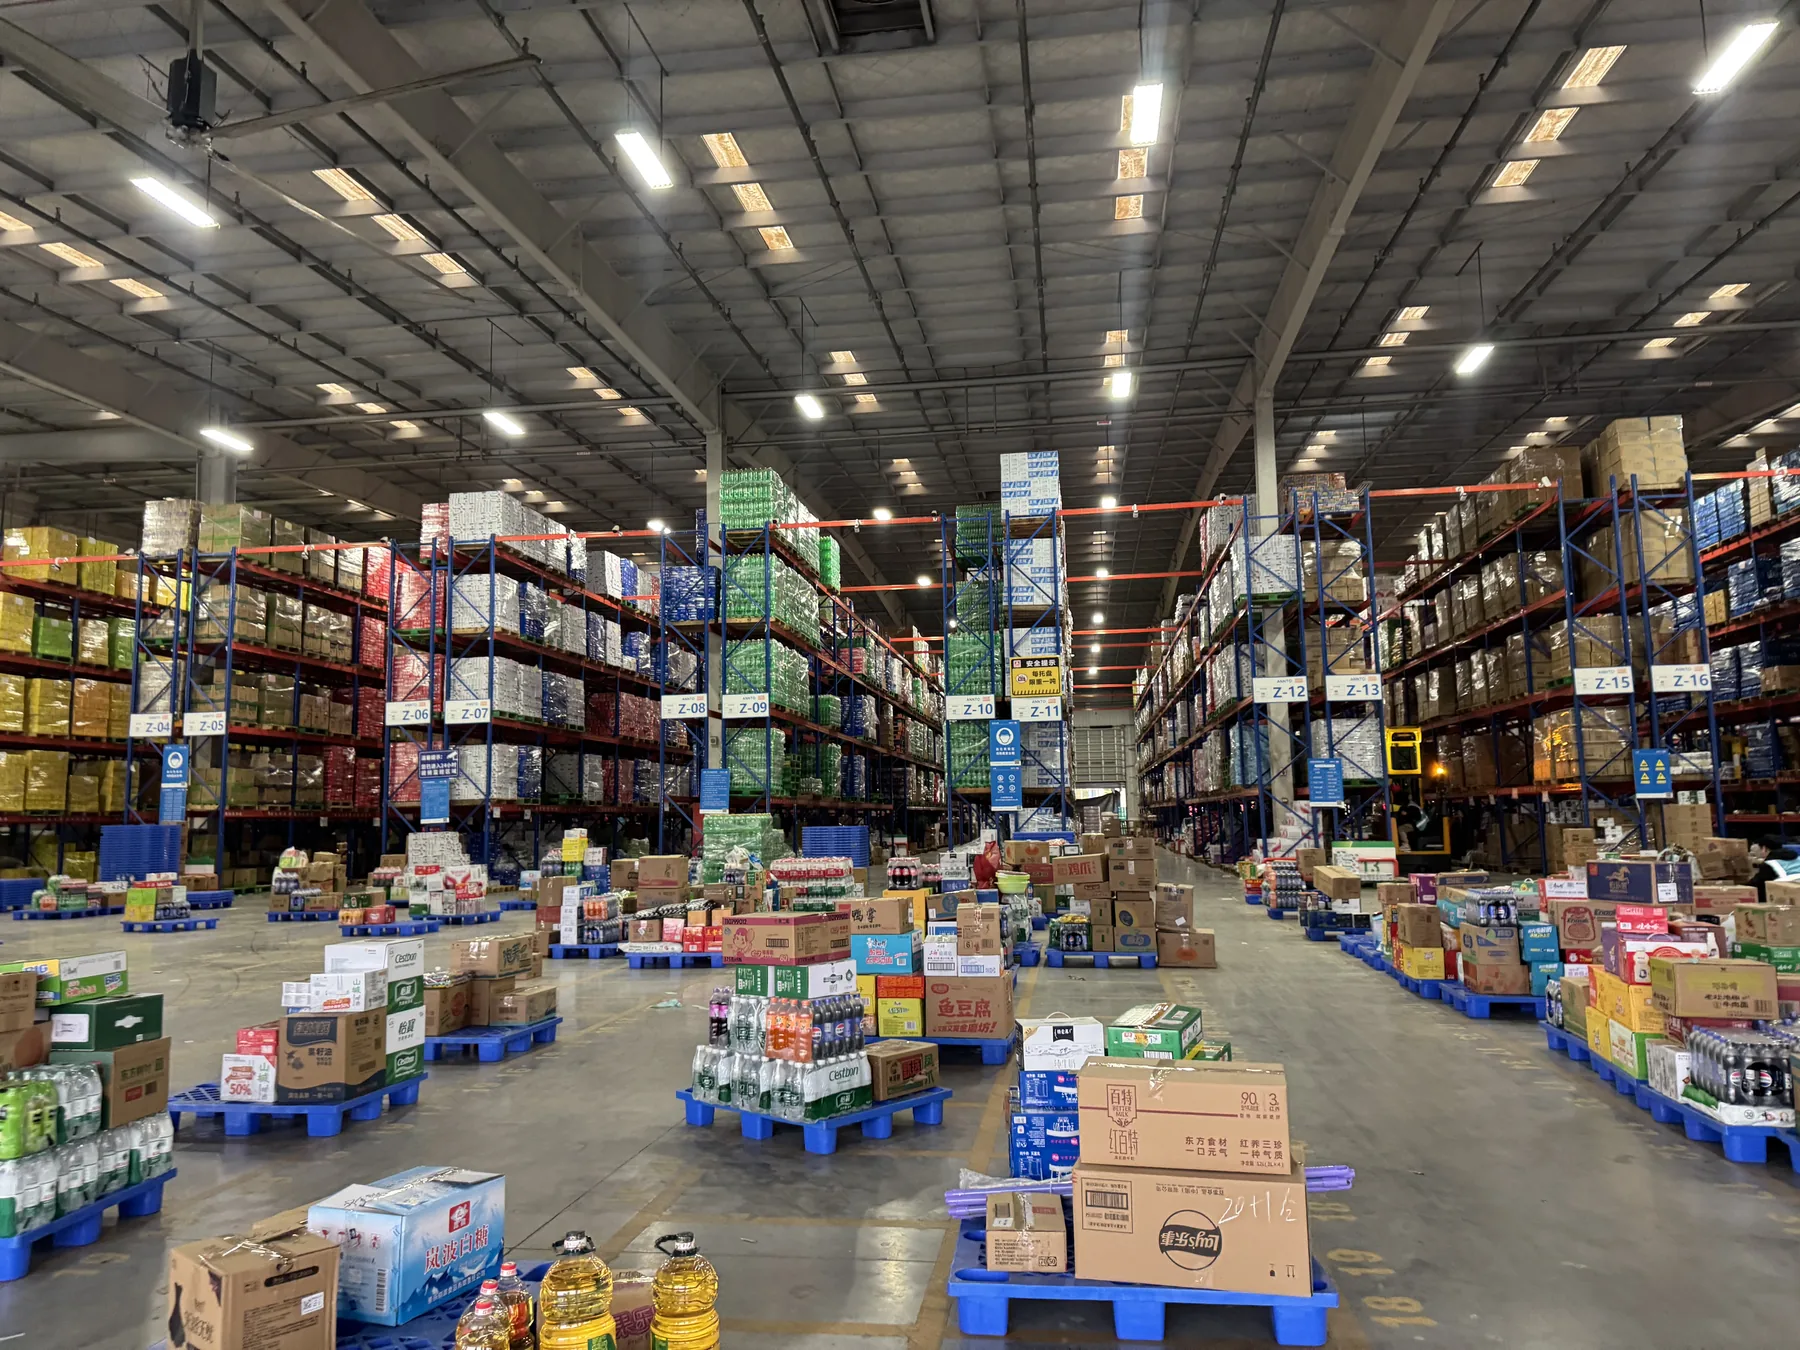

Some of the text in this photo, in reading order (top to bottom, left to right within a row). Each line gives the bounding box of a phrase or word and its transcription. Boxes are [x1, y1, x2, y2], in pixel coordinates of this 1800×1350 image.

[1026, 659, 1056, 667] 安全提示
[1595, 676, 1630, 689] Z-15
[1673, 673, 1709, 687] Z-16
[1273, 685, 1305, 698] Z-12
[1346, 683, 1380, 696] Z-13
[461, 708, 489, 720] Z-07
[678, 702, 706, 714] Z-08
[739, 702, 767, 714] Z-09
[963, 703, 993, 715] Z-10
[1030, 705, 1059, 718] Z-11
[402, 709, 429, 721] Z-06
[145, 722, 170, 733] Z-04
[199, 720, 224, 731] Z-05
[937, 997, 992, 1018] 鱼豆腐
[829, 1066, 859, 1081] C'estbon
[229, 1083, 252, 1096] 50%
[1110, 1088, 1133, 1106] 百特
[1185, 1136, 1282, 1149] 东方食材 红养三珍
[1185, 1147, 1283, 1160] 一口元气 一种气质
[424, 1224, 489, 1275] 岚波白糖
